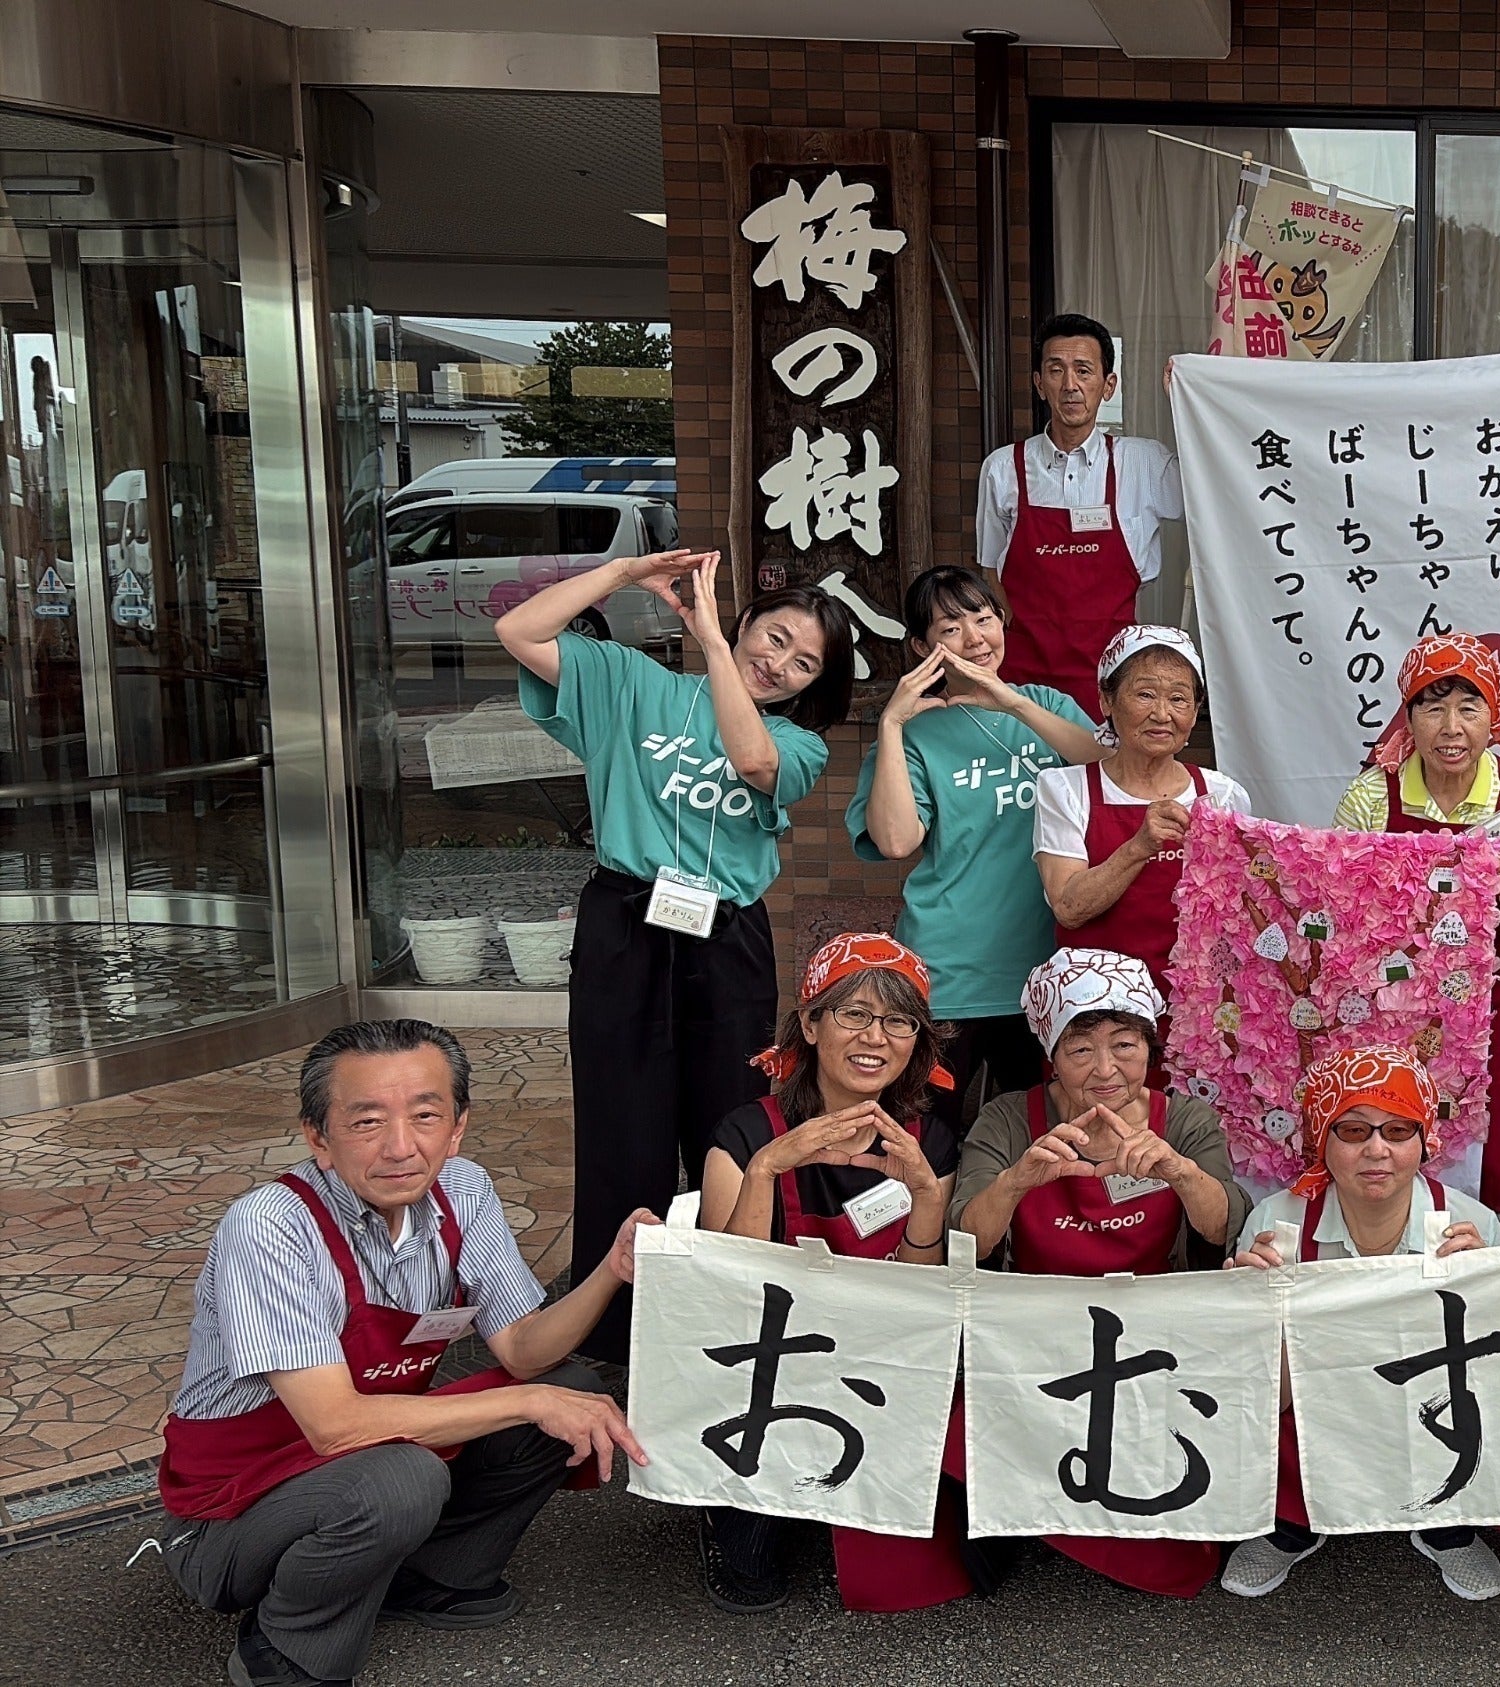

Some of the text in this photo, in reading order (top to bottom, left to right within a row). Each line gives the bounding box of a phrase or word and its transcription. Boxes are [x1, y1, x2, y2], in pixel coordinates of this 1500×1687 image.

[1278, 217, 1362, 256] ホッとするね
[1290, 201, 1364, 233] 相談できると
[1035, 543, 1100, 556] ジーバーFOOD
[1251, 428, 1314, 666] 食べてって。
[1407, 423, 1454, 638] じーちゃん
[659, 771, 755, 818] FOO
[362, 1354, 442, 1380] ジーバーF
